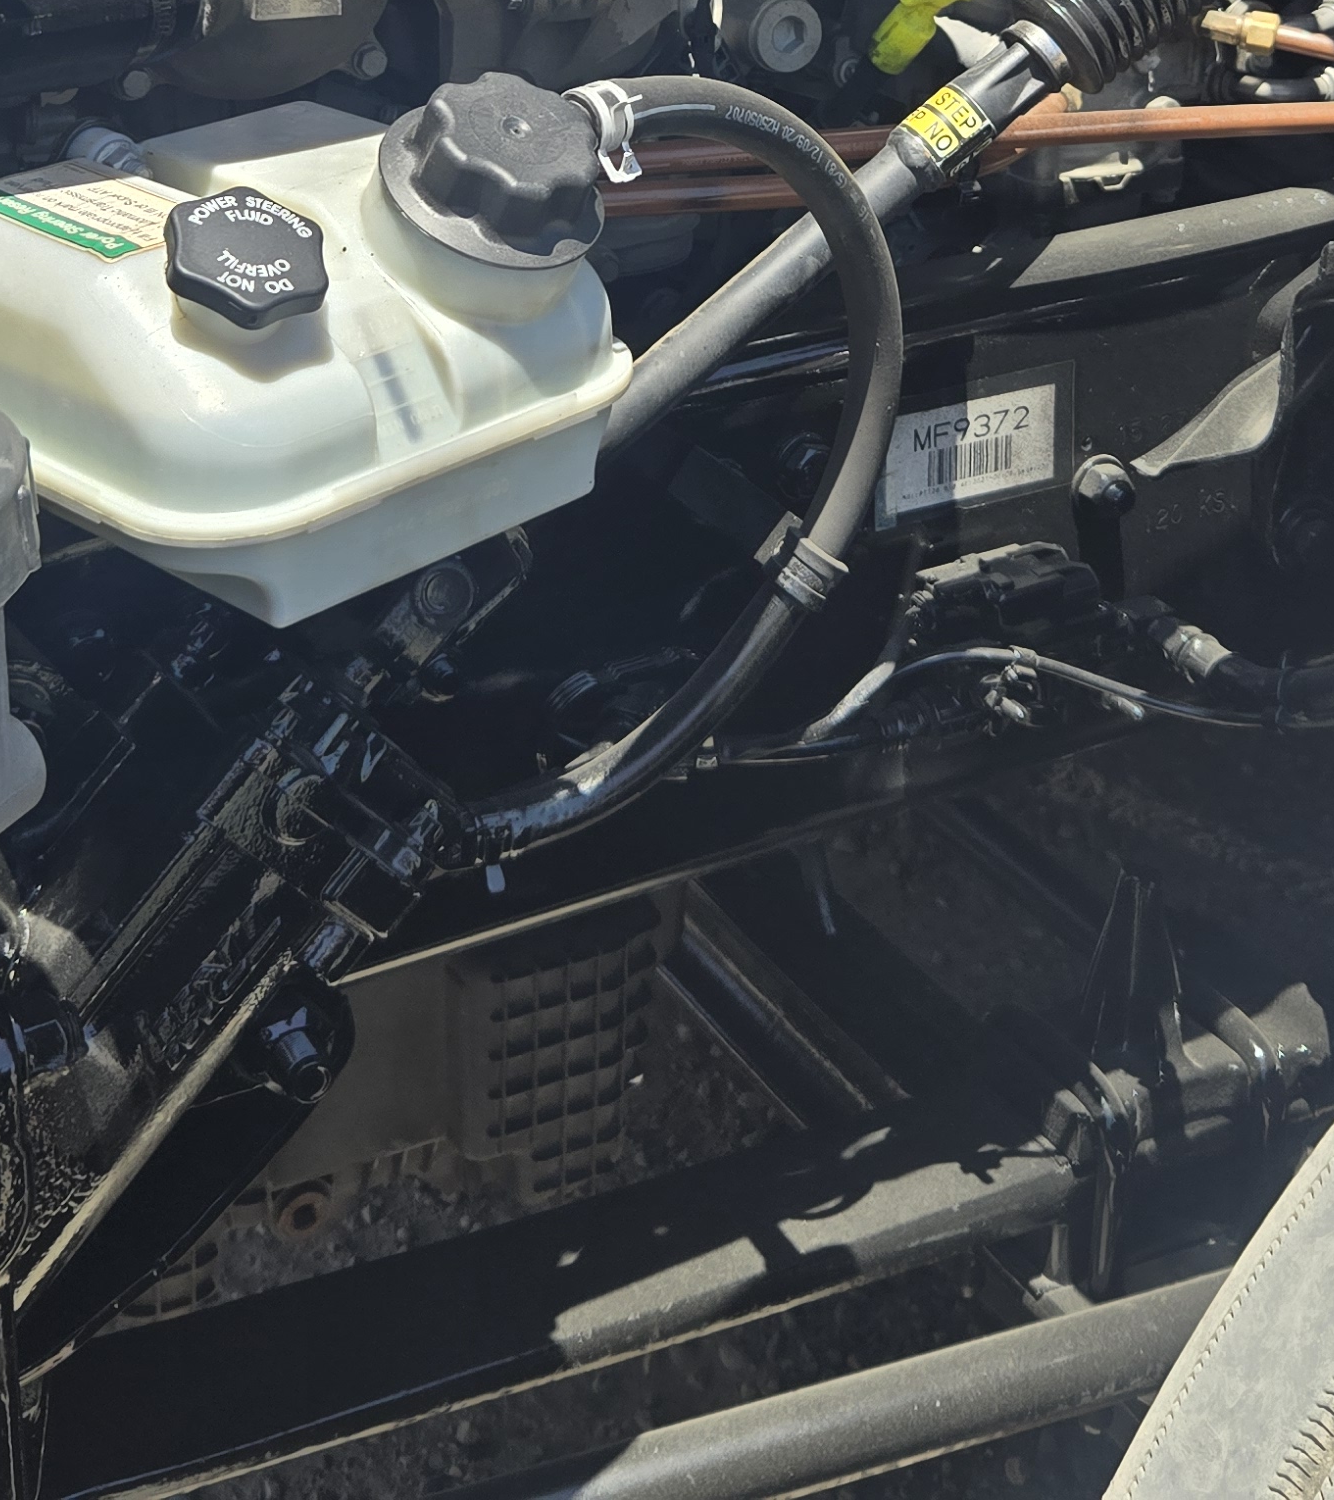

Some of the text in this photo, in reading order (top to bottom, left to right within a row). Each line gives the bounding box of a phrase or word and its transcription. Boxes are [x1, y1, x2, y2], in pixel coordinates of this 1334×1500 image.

[935, 92, 977, 130] STEP
[924, 121, 953, 151] NO
[188, 195, 238, 226] POWER
[245, 195, 313, 239] STEERING
[224, 209, 274, 226] FLUID
[217, 249, 292, 278] OVERFILL
[217, 274, 295, 294] DO NOT
[913, 405, 1030, 453] MF9372
